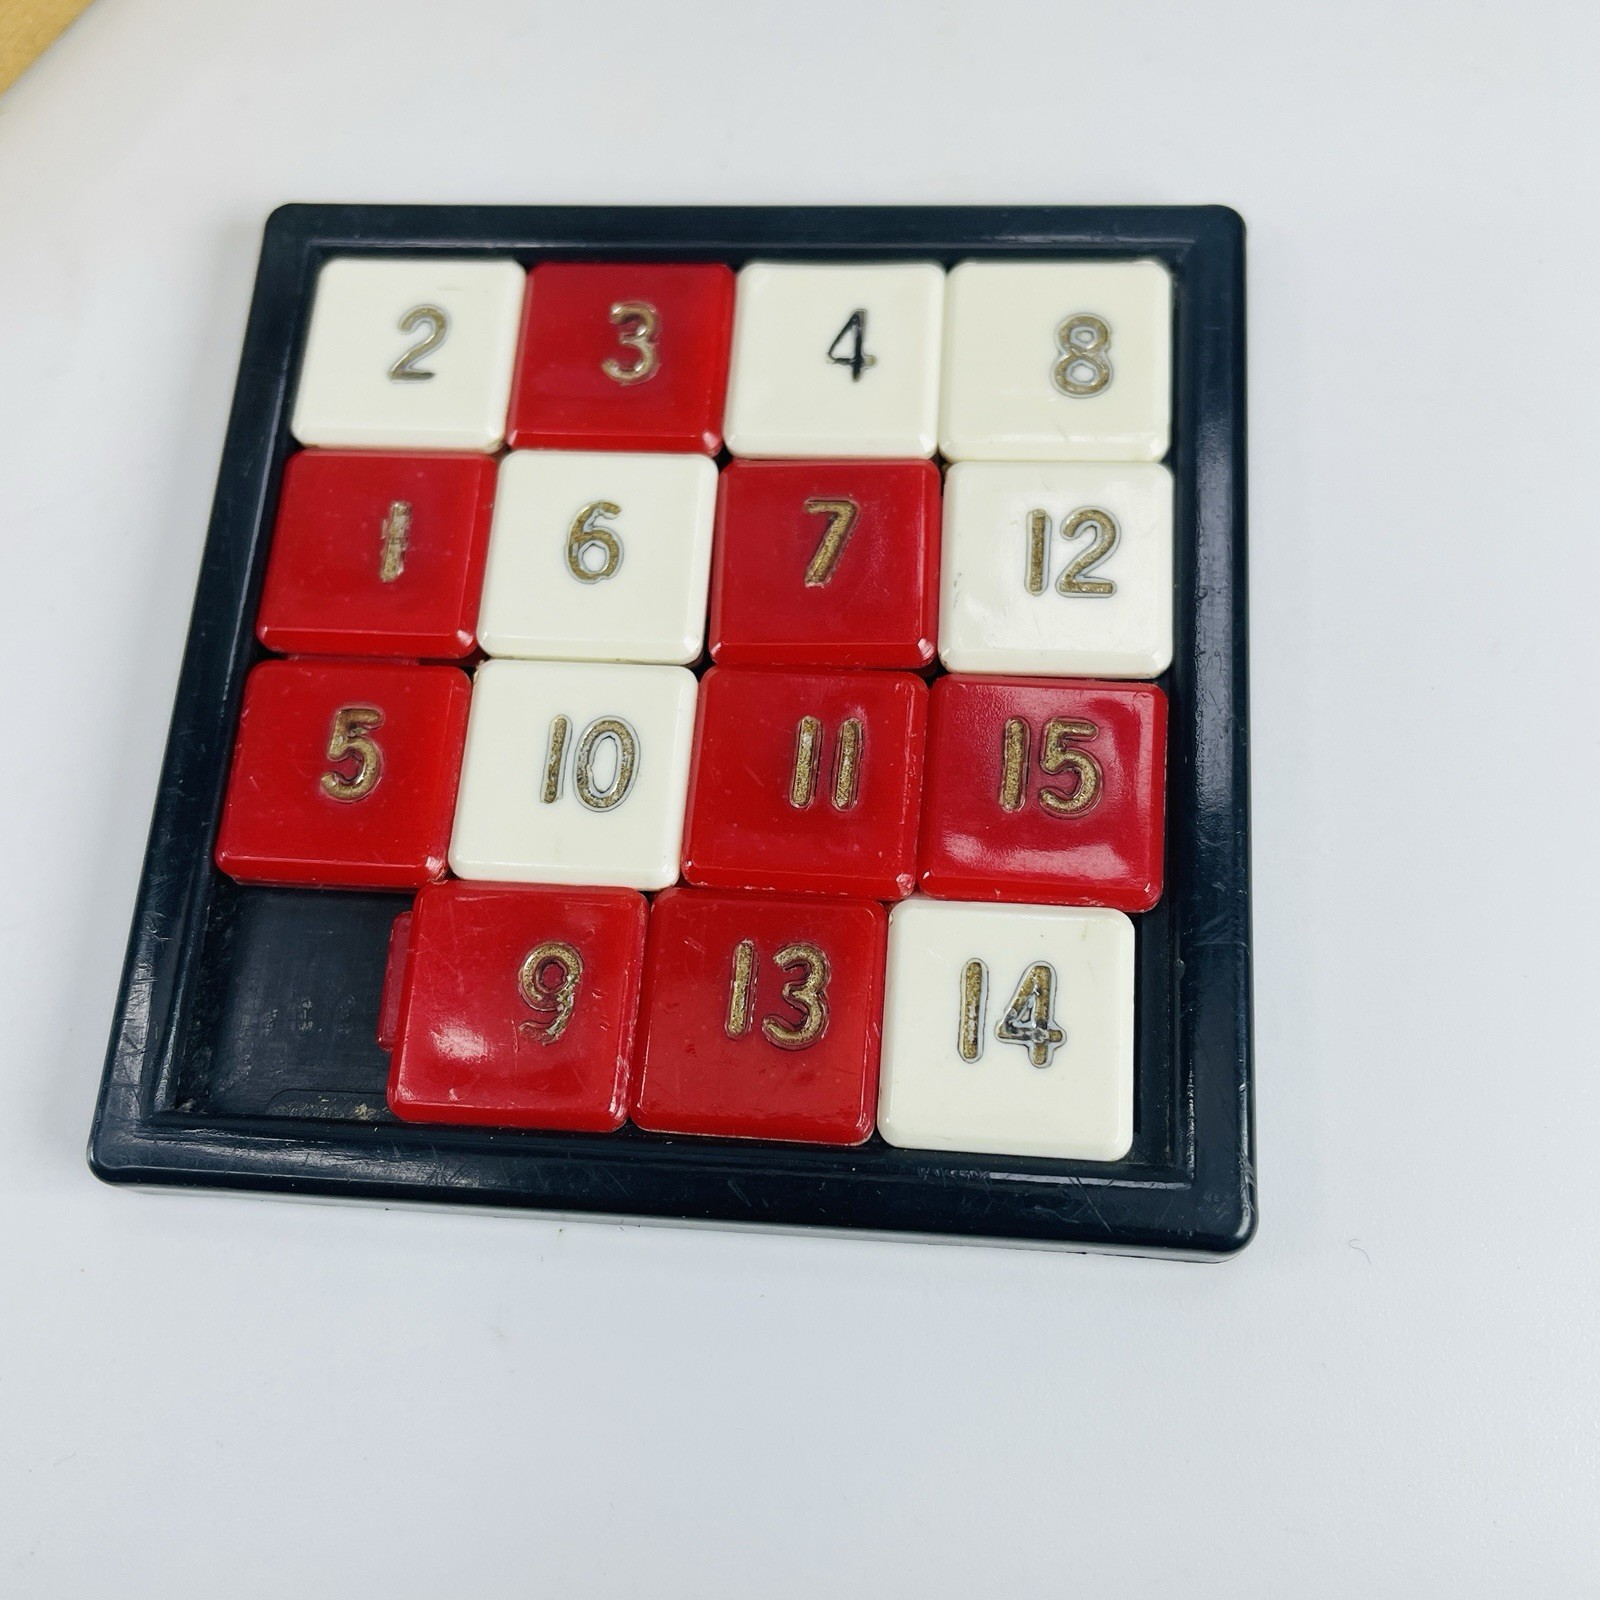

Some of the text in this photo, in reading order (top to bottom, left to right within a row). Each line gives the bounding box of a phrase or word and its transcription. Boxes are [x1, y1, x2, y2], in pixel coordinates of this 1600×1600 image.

[389, 304, 448, 382] 2
[602, 302, 658, 385] 3
[827, 309, 877, 383] 4
[1053, 313, 1112, 398] 8
[379, 501, 410, 583] 1
[565, 498, 622, 585] 6
[805, 499, 858, 588] 7
[1024, 506, 1121, 599] 12
[318, 705, 385, 802] 5
[541, 715, 641, 813] 10
[790, 715, 865, 812] 11
[1000, 717, 1102, 819] 15
[516, 942, 584, 1045] 9
[726, 939, 831, 1049] 13
[958, 958, 1067, 1068] 14
